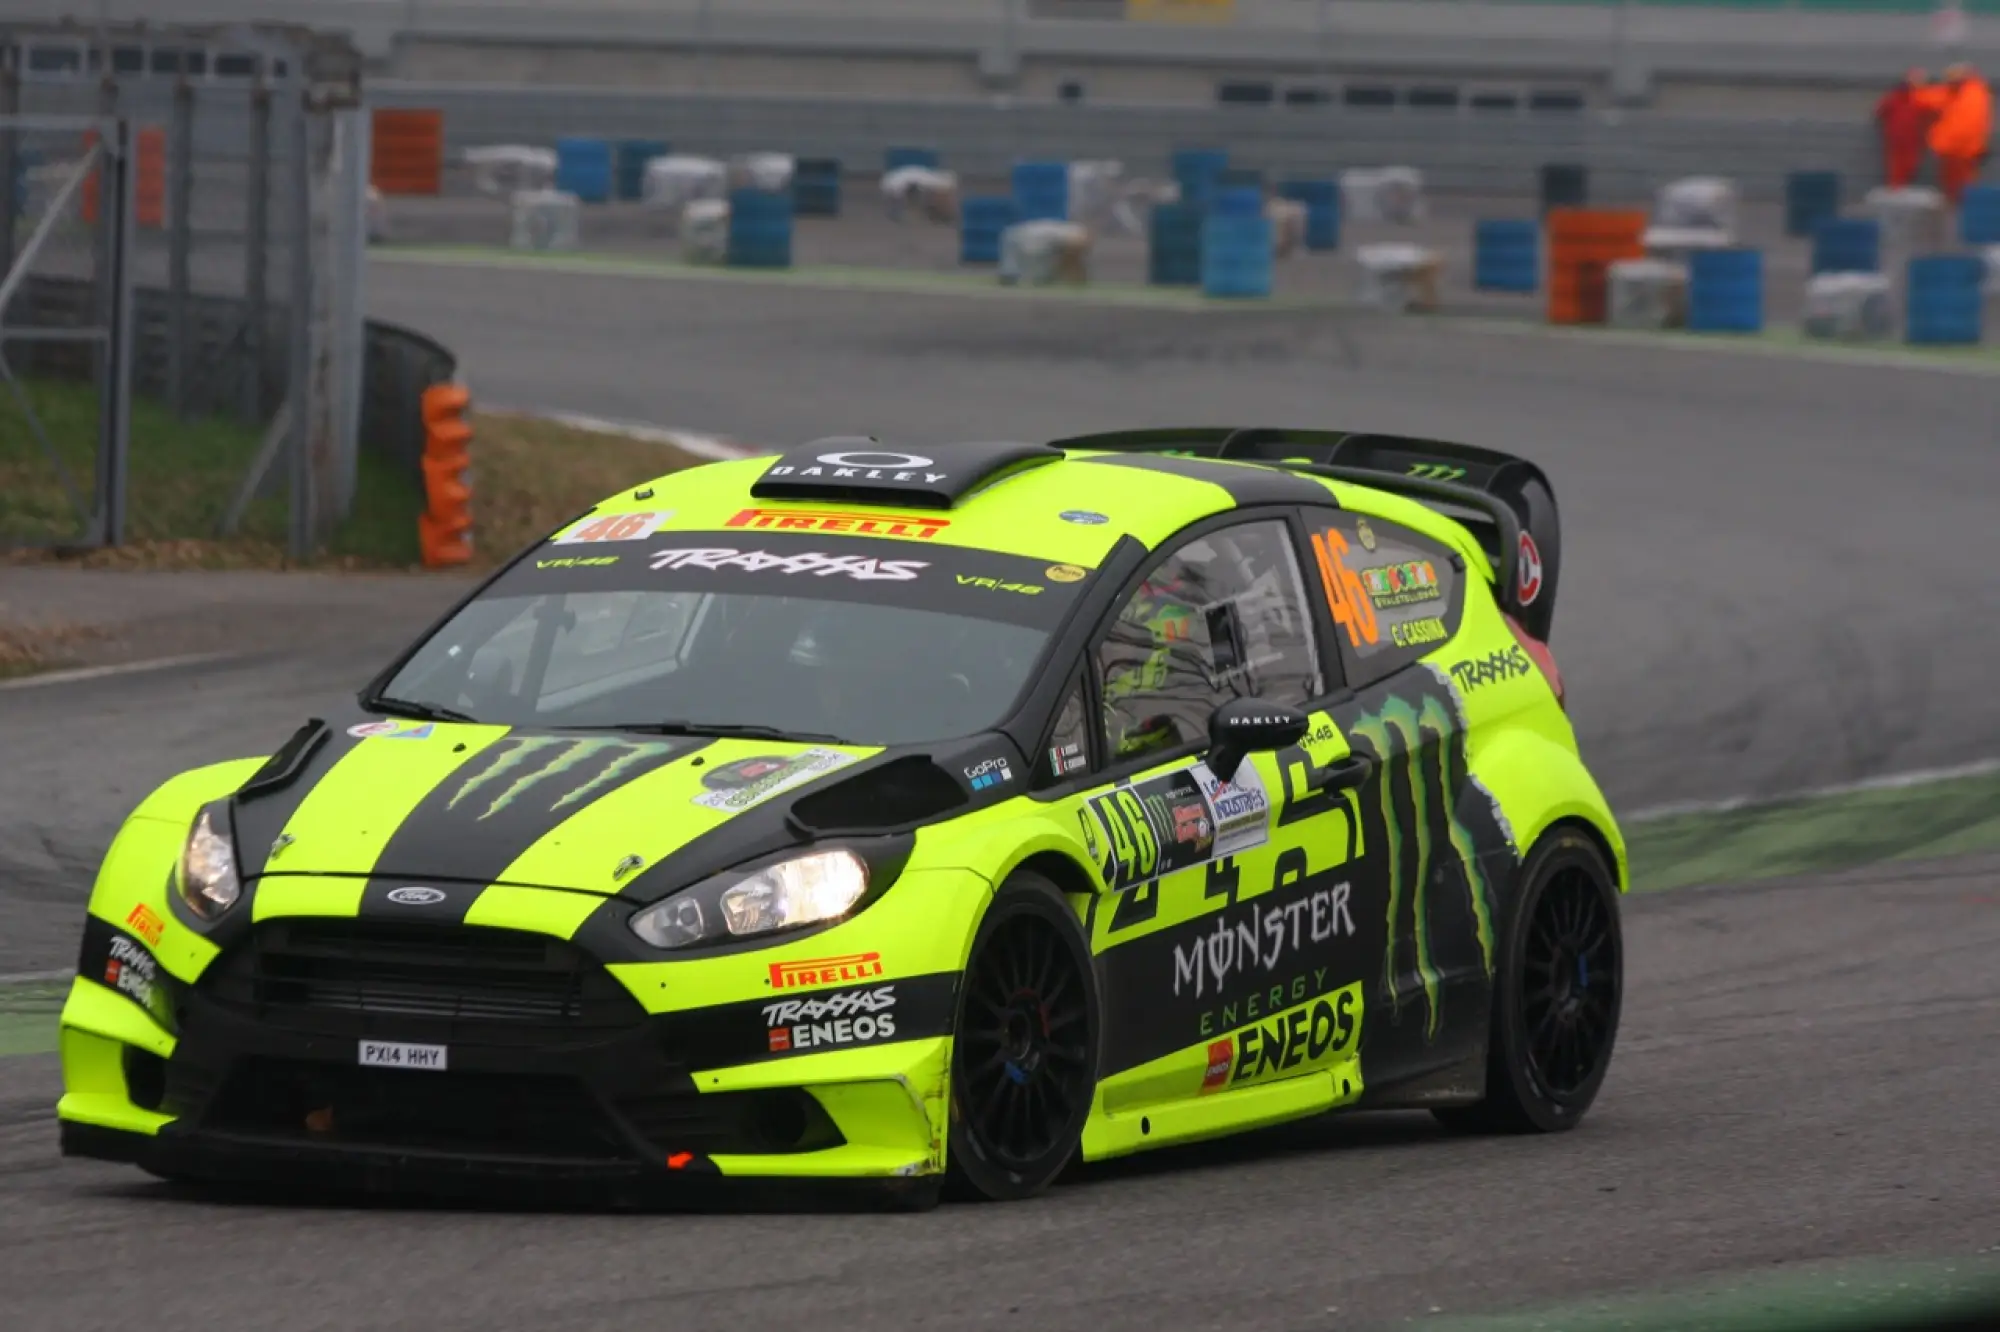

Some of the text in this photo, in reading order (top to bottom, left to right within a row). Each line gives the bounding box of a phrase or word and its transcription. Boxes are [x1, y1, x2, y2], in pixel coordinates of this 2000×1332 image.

[769, 466, 947, 483] OAKLEY
[573, 512, 655, 541] 46
[724, 509, 950, 538] PIRELLI
[648, 547, 932, 580] TRAXXAS
[1311, 528, 1379, 647] 46
[1230, 716, 1290, 726] OAKLEY
[963, 757, 1007, 778] GoPro
[1099, 791, 1156, 880] 46
[768, 952, 884, 989] PIRELLI
[761, 985, 897, 1027] TRAXXAS
[1200, 967, 1328, 1036] ENERGY
[793, 1013, 896, 1049] ENEOS
[1232, 990, 1354, 1081] ENEOS
[366, 1045, 440, 1065] PX14 HHY
